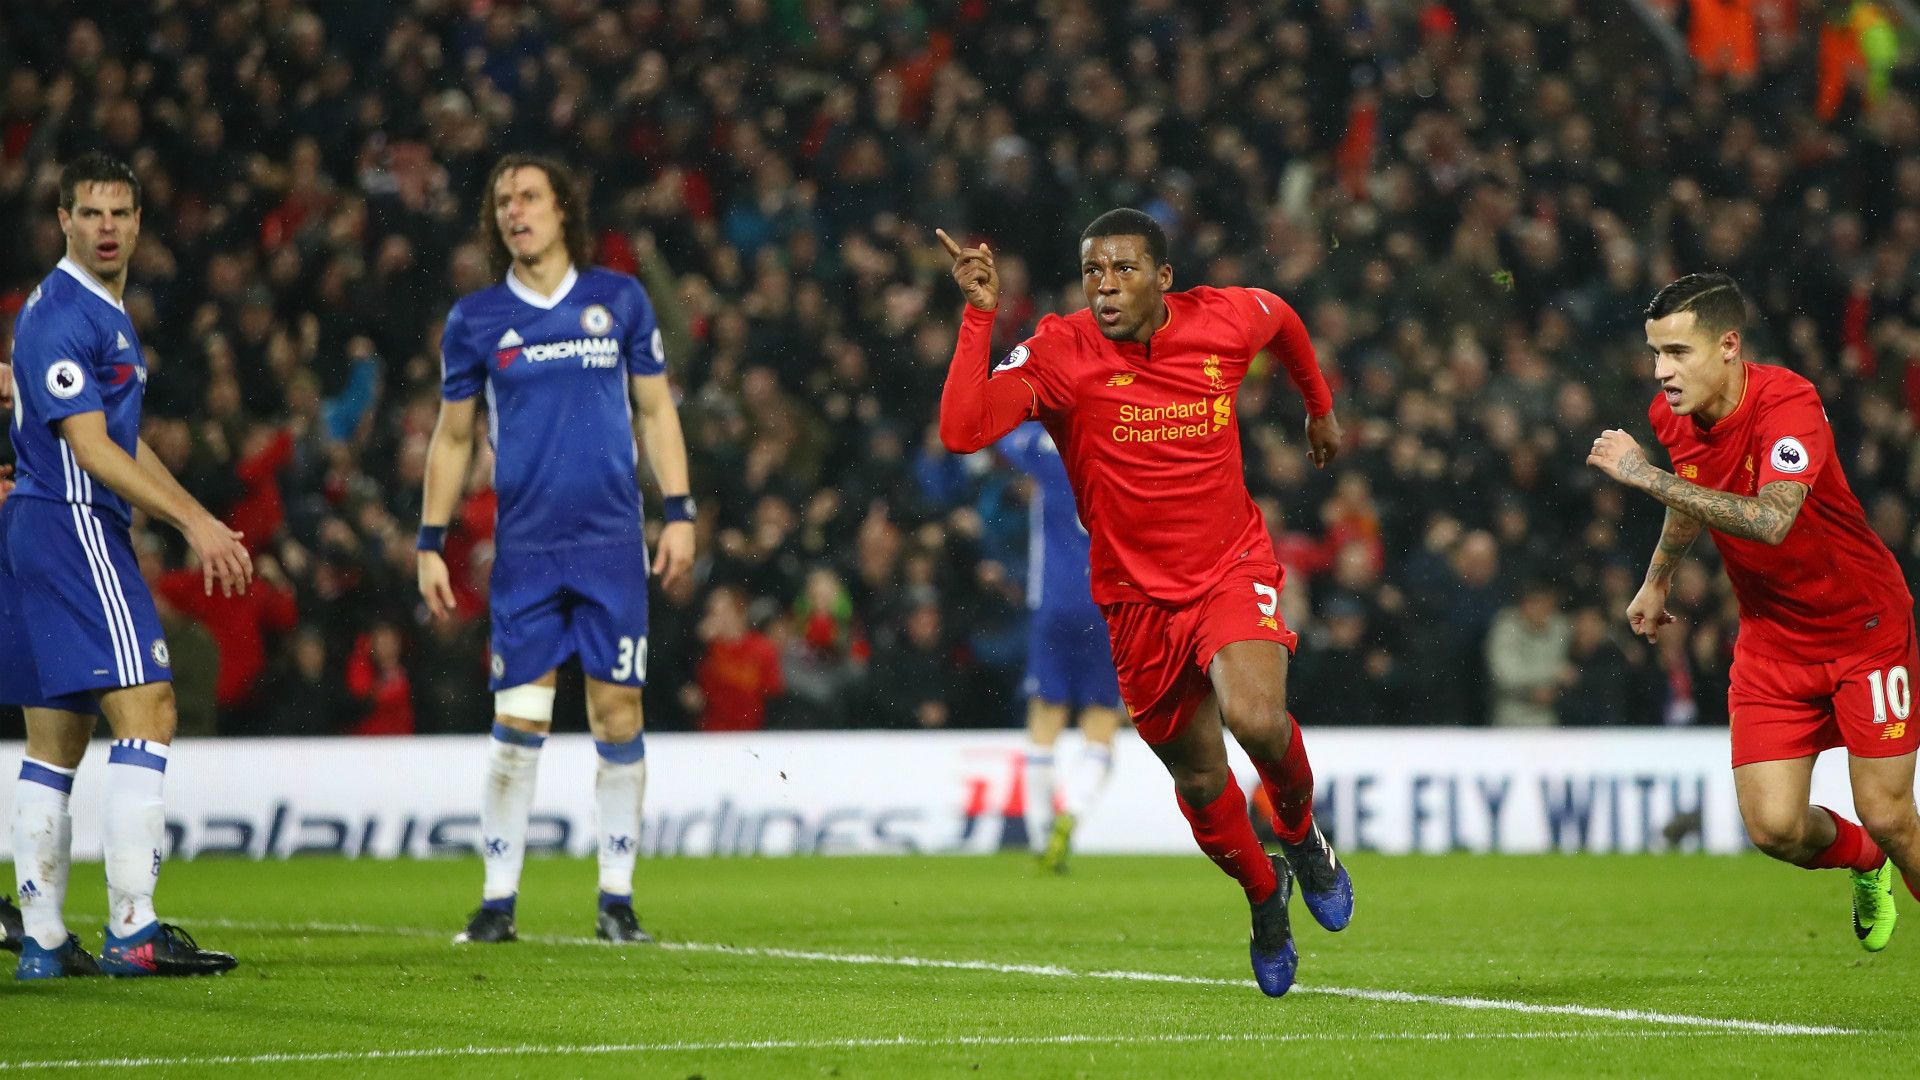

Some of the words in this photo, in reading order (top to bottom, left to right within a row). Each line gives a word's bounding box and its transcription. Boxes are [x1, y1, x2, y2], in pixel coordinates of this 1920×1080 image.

[522, 337, 619, 362] YOKOHAMA
[1119, 397, 1208, 423] Standard
[1112, 418, 1209, 442] Chartered
[611, 635, 648, 682] 30
[1867, 665, 1911, 724] 10
[1412, 775, 1512, 850] FLY
[1540, 773, 1708, 851] WITH
